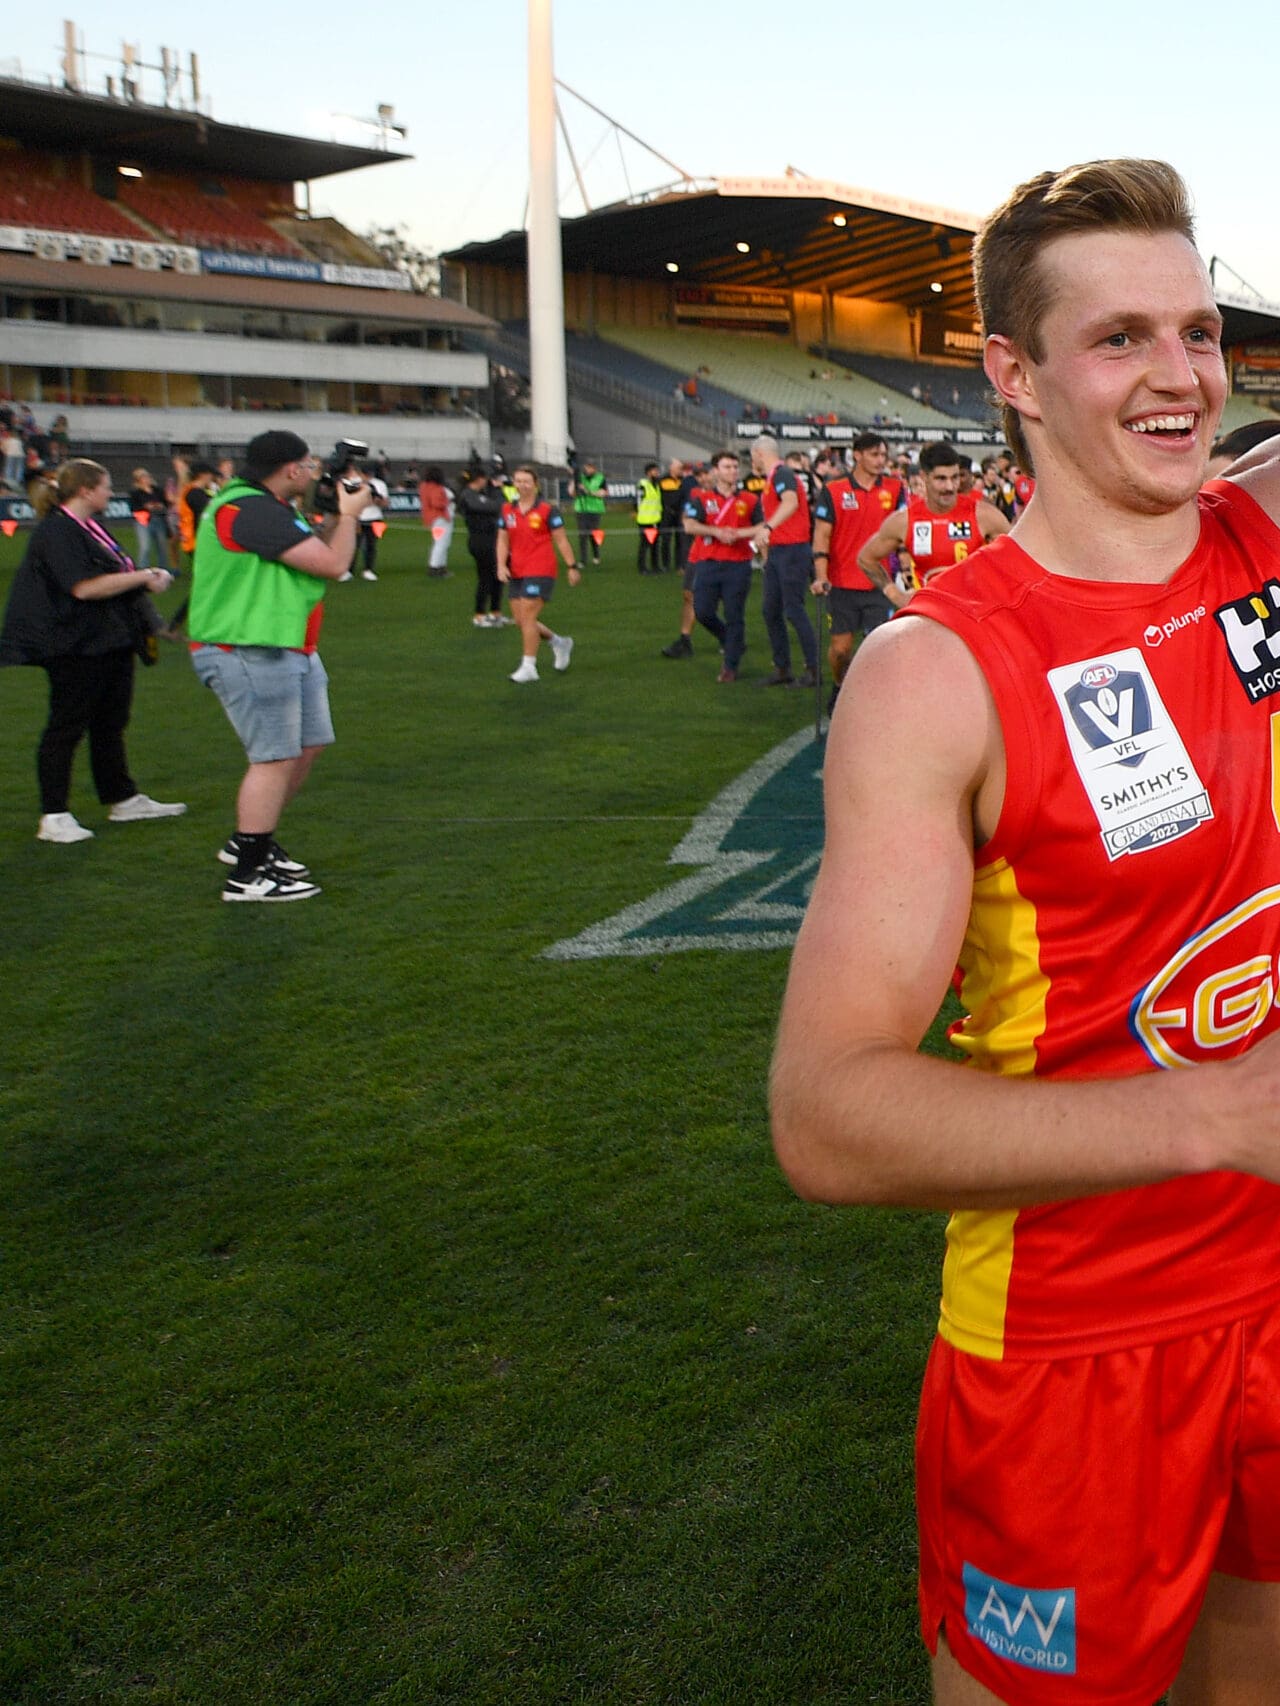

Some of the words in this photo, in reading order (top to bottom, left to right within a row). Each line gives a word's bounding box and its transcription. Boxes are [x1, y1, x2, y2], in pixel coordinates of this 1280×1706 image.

[955, 541, 969, 563] 6
[1084, 665, 1118, 685] AFL
[1113, 740, 1142, 757] VFL
[1100, 766, 1189, 811] SMITHY'S
[1111, 815, 1159, 849] GRAND
[1159, 800, 1207, 823] FINAL
[1150, 822, 1179, 842] 2023
